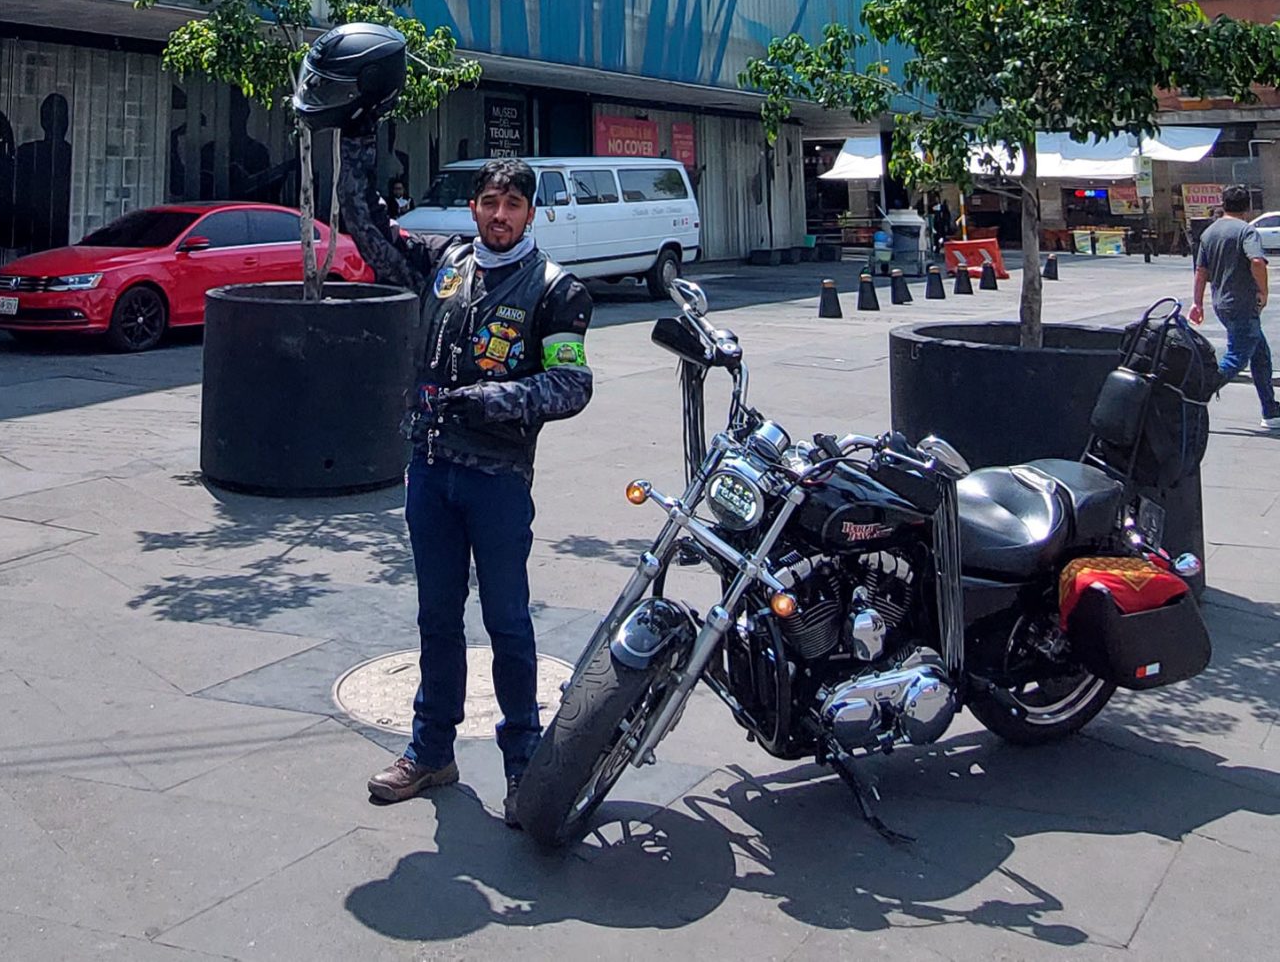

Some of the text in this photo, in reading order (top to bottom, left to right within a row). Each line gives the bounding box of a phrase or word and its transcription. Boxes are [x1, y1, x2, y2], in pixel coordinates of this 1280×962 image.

[491, 106, 518, 119] MUSEO
[489, 127, 521, 140] TEQUILA
[608, 138, 623, 155] NO
[624, 139, 653, 157] COVER
